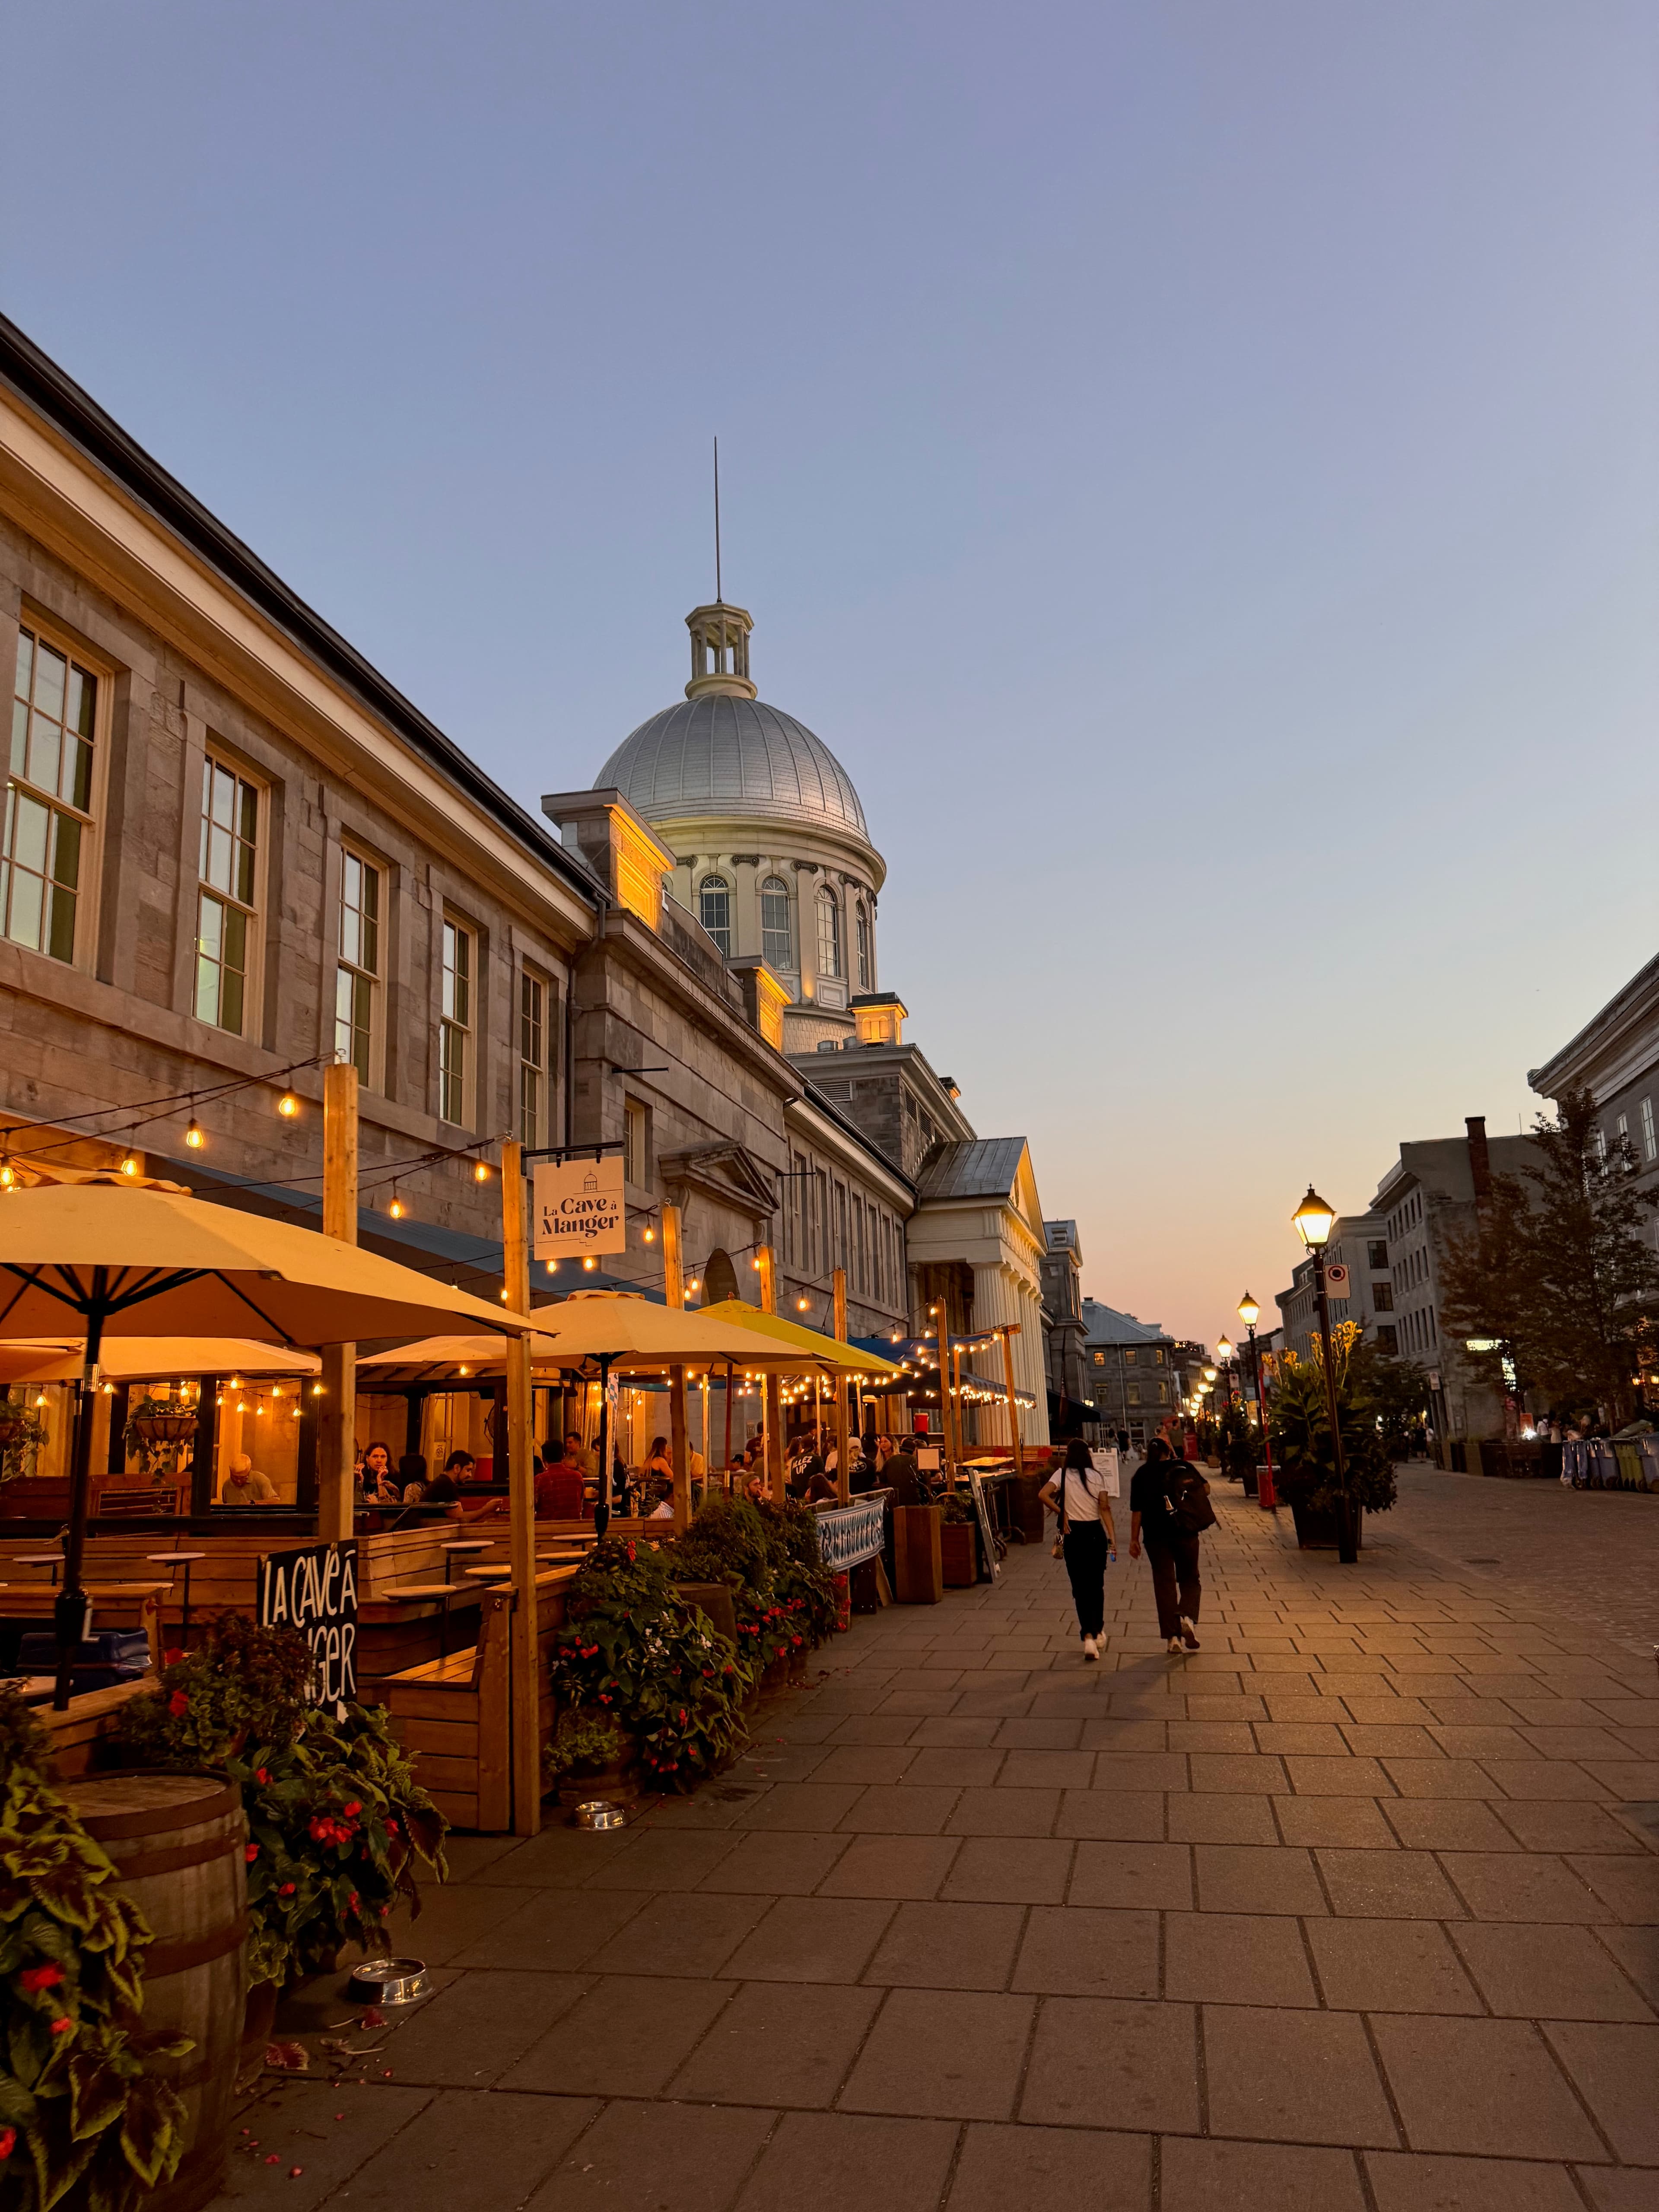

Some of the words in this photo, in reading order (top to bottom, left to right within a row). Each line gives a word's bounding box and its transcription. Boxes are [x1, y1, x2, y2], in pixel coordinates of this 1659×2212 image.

[543, 1206, 557, 1216] La
[560, 1198, 607, 1214] Cave
[610, 1201, 617, 1210] à
[542, 1215, 619, 1238] Manger
[796, 1463, 807, 1475] UP
